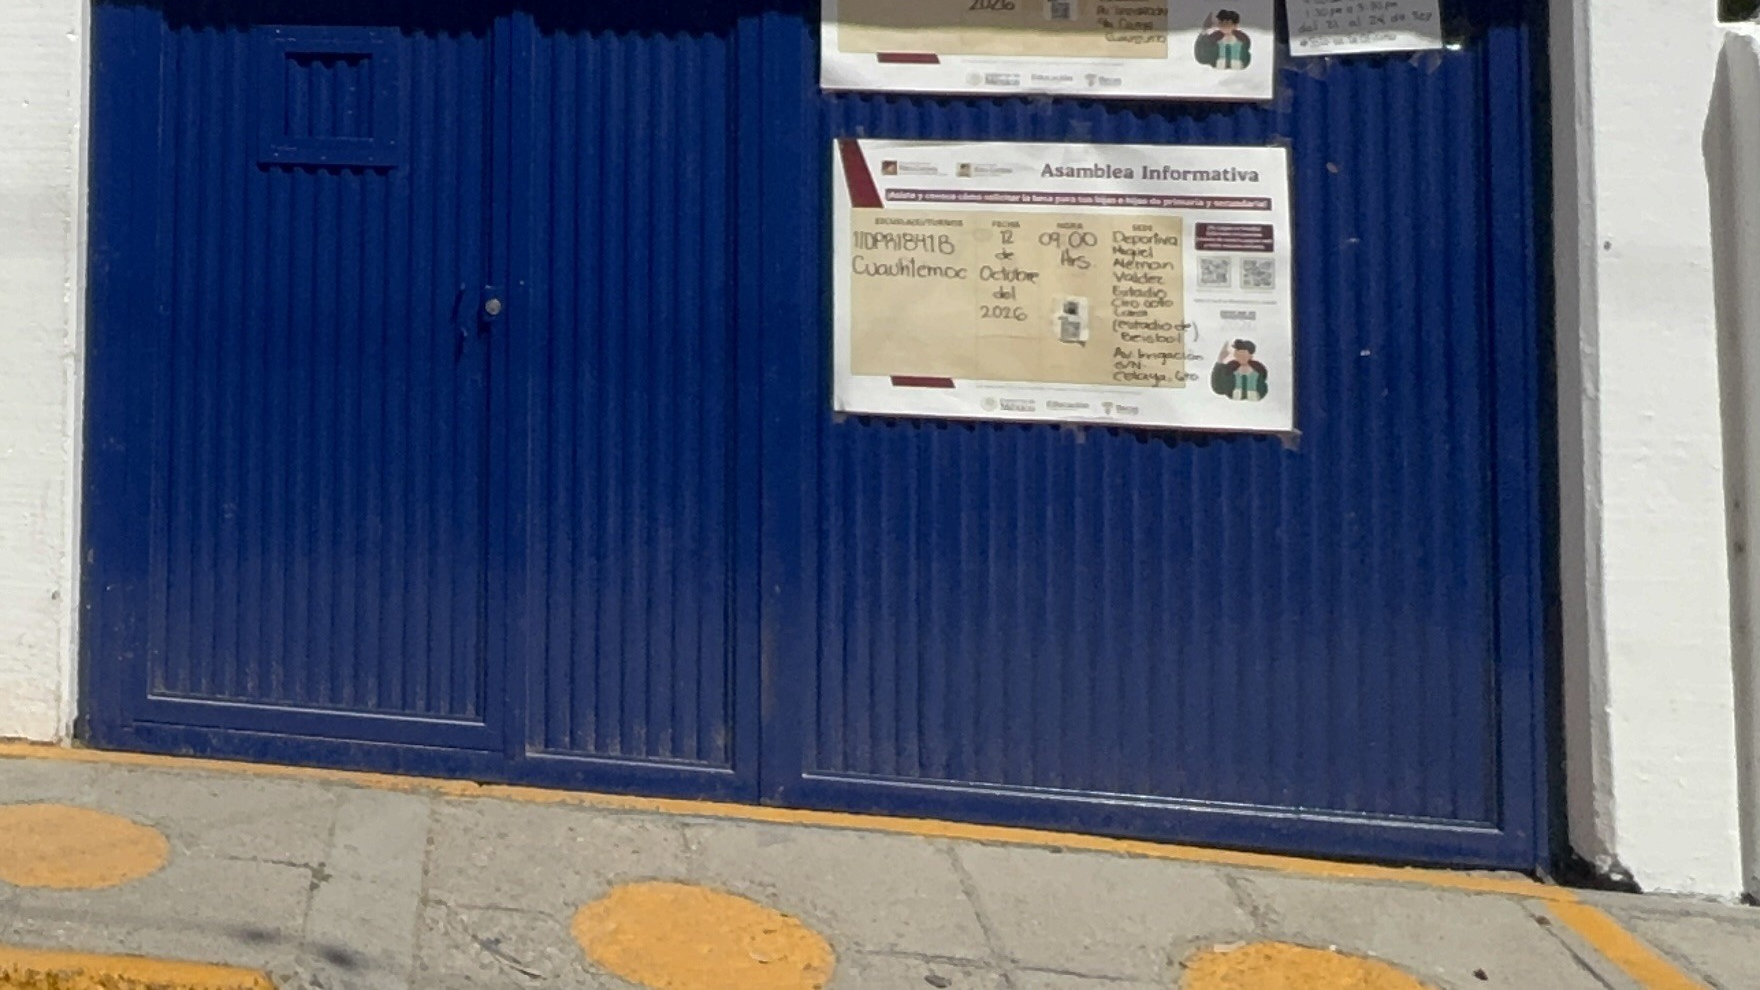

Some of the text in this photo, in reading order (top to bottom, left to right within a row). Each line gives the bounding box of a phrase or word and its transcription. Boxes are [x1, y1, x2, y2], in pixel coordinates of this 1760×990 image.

[1040, 163, 1260, 183] Asamblea Informativa
[1000, 230, 1014, 244] 12
[1112, 230, 1178, 246] Deportiva
[995, 247, 1014, 260] de
[980, 265, 1039, 284] Octubre
[992, 285, 1016, 301] del
[980, 305, 1028, 321] 2026
